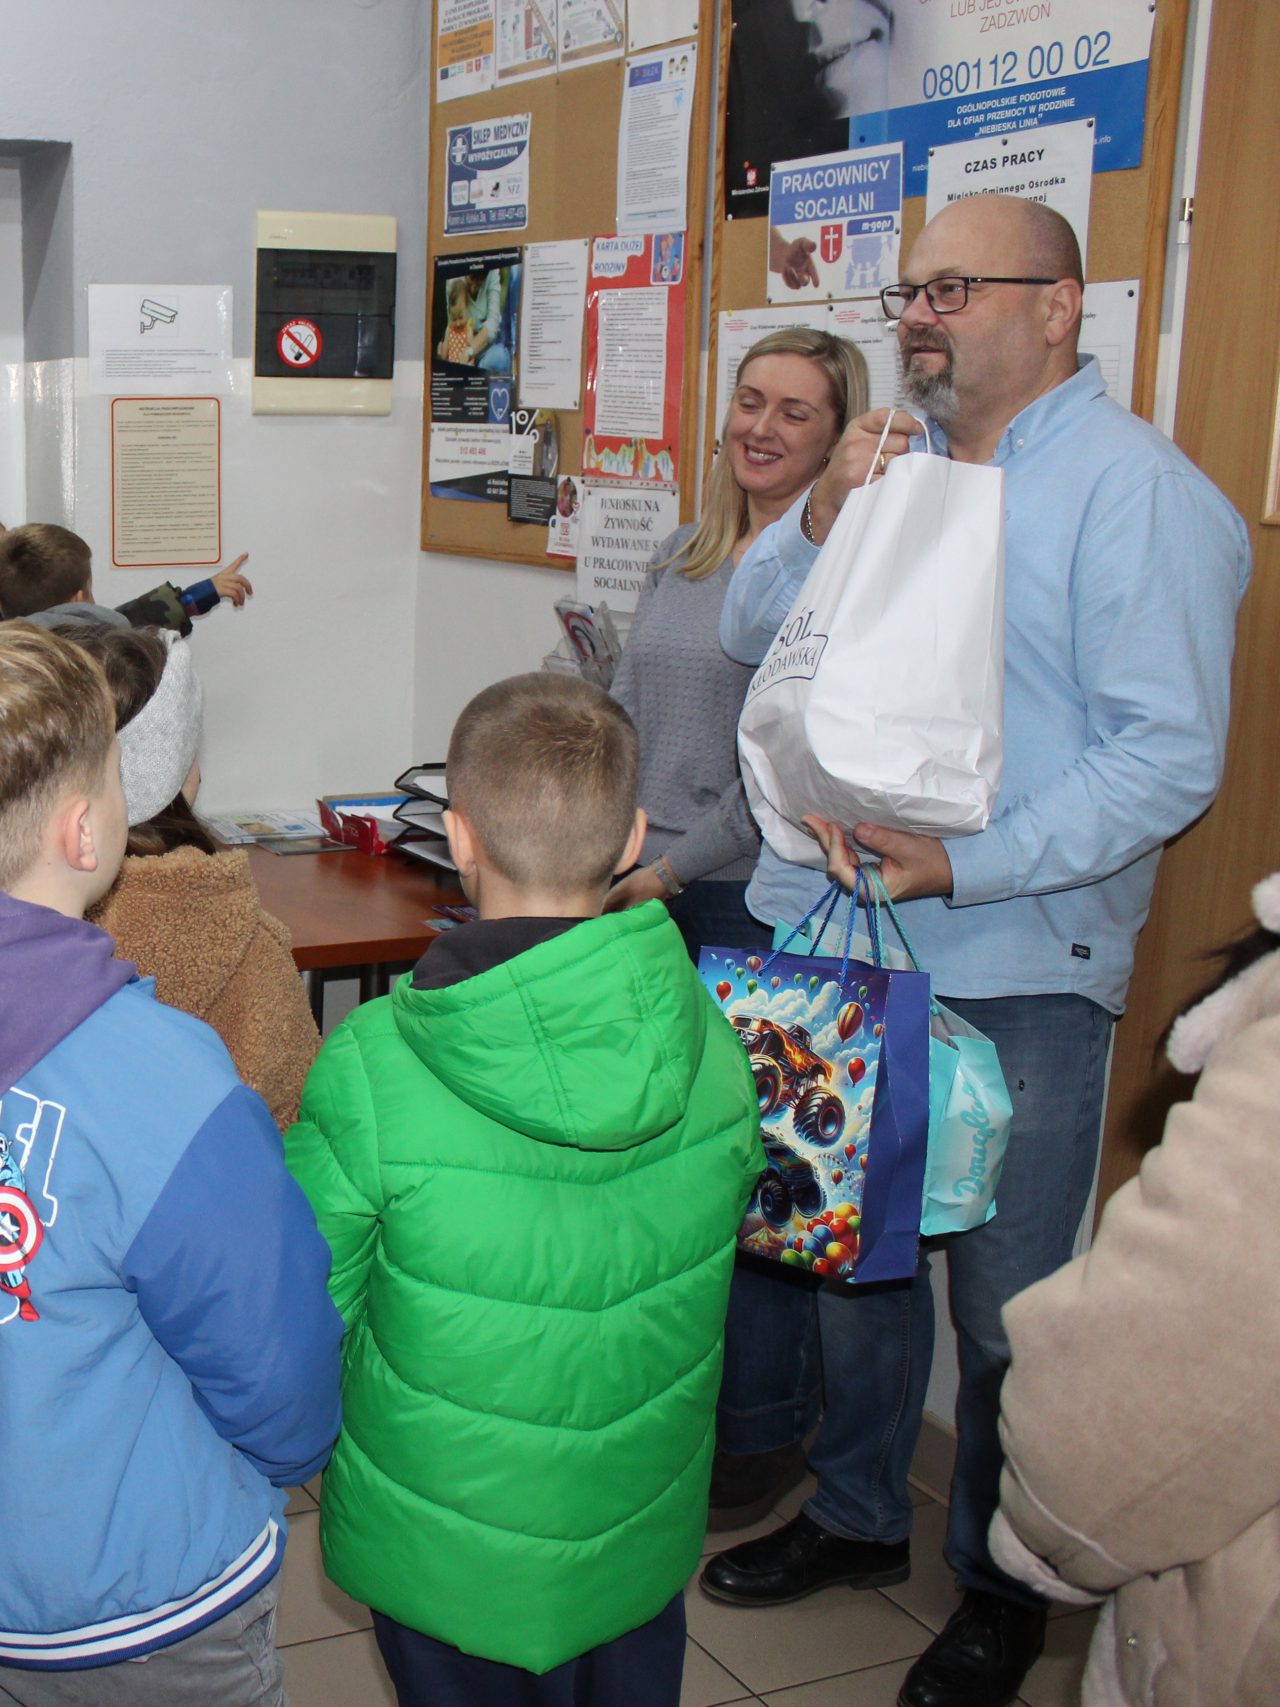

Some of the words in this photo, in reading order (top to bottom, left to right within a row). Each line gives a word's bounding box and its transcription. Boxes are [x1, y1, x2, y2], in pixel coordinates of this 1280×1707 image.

[950, 0, 976, 18] LUB
[1028, 41, 1064, 79] 00
[1074, 30, 1111, 70] 02
[956, 96, 1017, 114] OGÓLNOPOLSKIE
[1020, 87, 1066, 102] POGOTOWIE
[947, 118, 962, 128] DLA
[963, 115, 985, 126] OFIAR
[987, 107, 1027, 123] PRZEMOCY
[1029, 106, 1036, 114] W
[1038, 98, 1075, 113] RODZINIE
[473, 127, 491, 145] SKLEP
[494, 120, 529, 142] MEDYCZNY
[964, 157, 997, 174] CZAS
[1001, 148, 1045, 168] PRACY
[781, 158, 891, 195] PRACOWNICY
[794, 191, 875, 220] SOCJALNI
[596, 240, 619, 251] KARTA
[594, 262, 626, 273] RODZINY
[644, 499, 660, 512] NA
[603, 515, 654, 532] ŻYWNOŚĆ
[591, 536, 651, 552] WYDAWANE
[584, 556, 592, 568] U
[593, 557, 650, 574] PRACOWNI
[593, 576, 642, 593] SOCJALNY
[952, 1082, 997, 1198] Douglas
